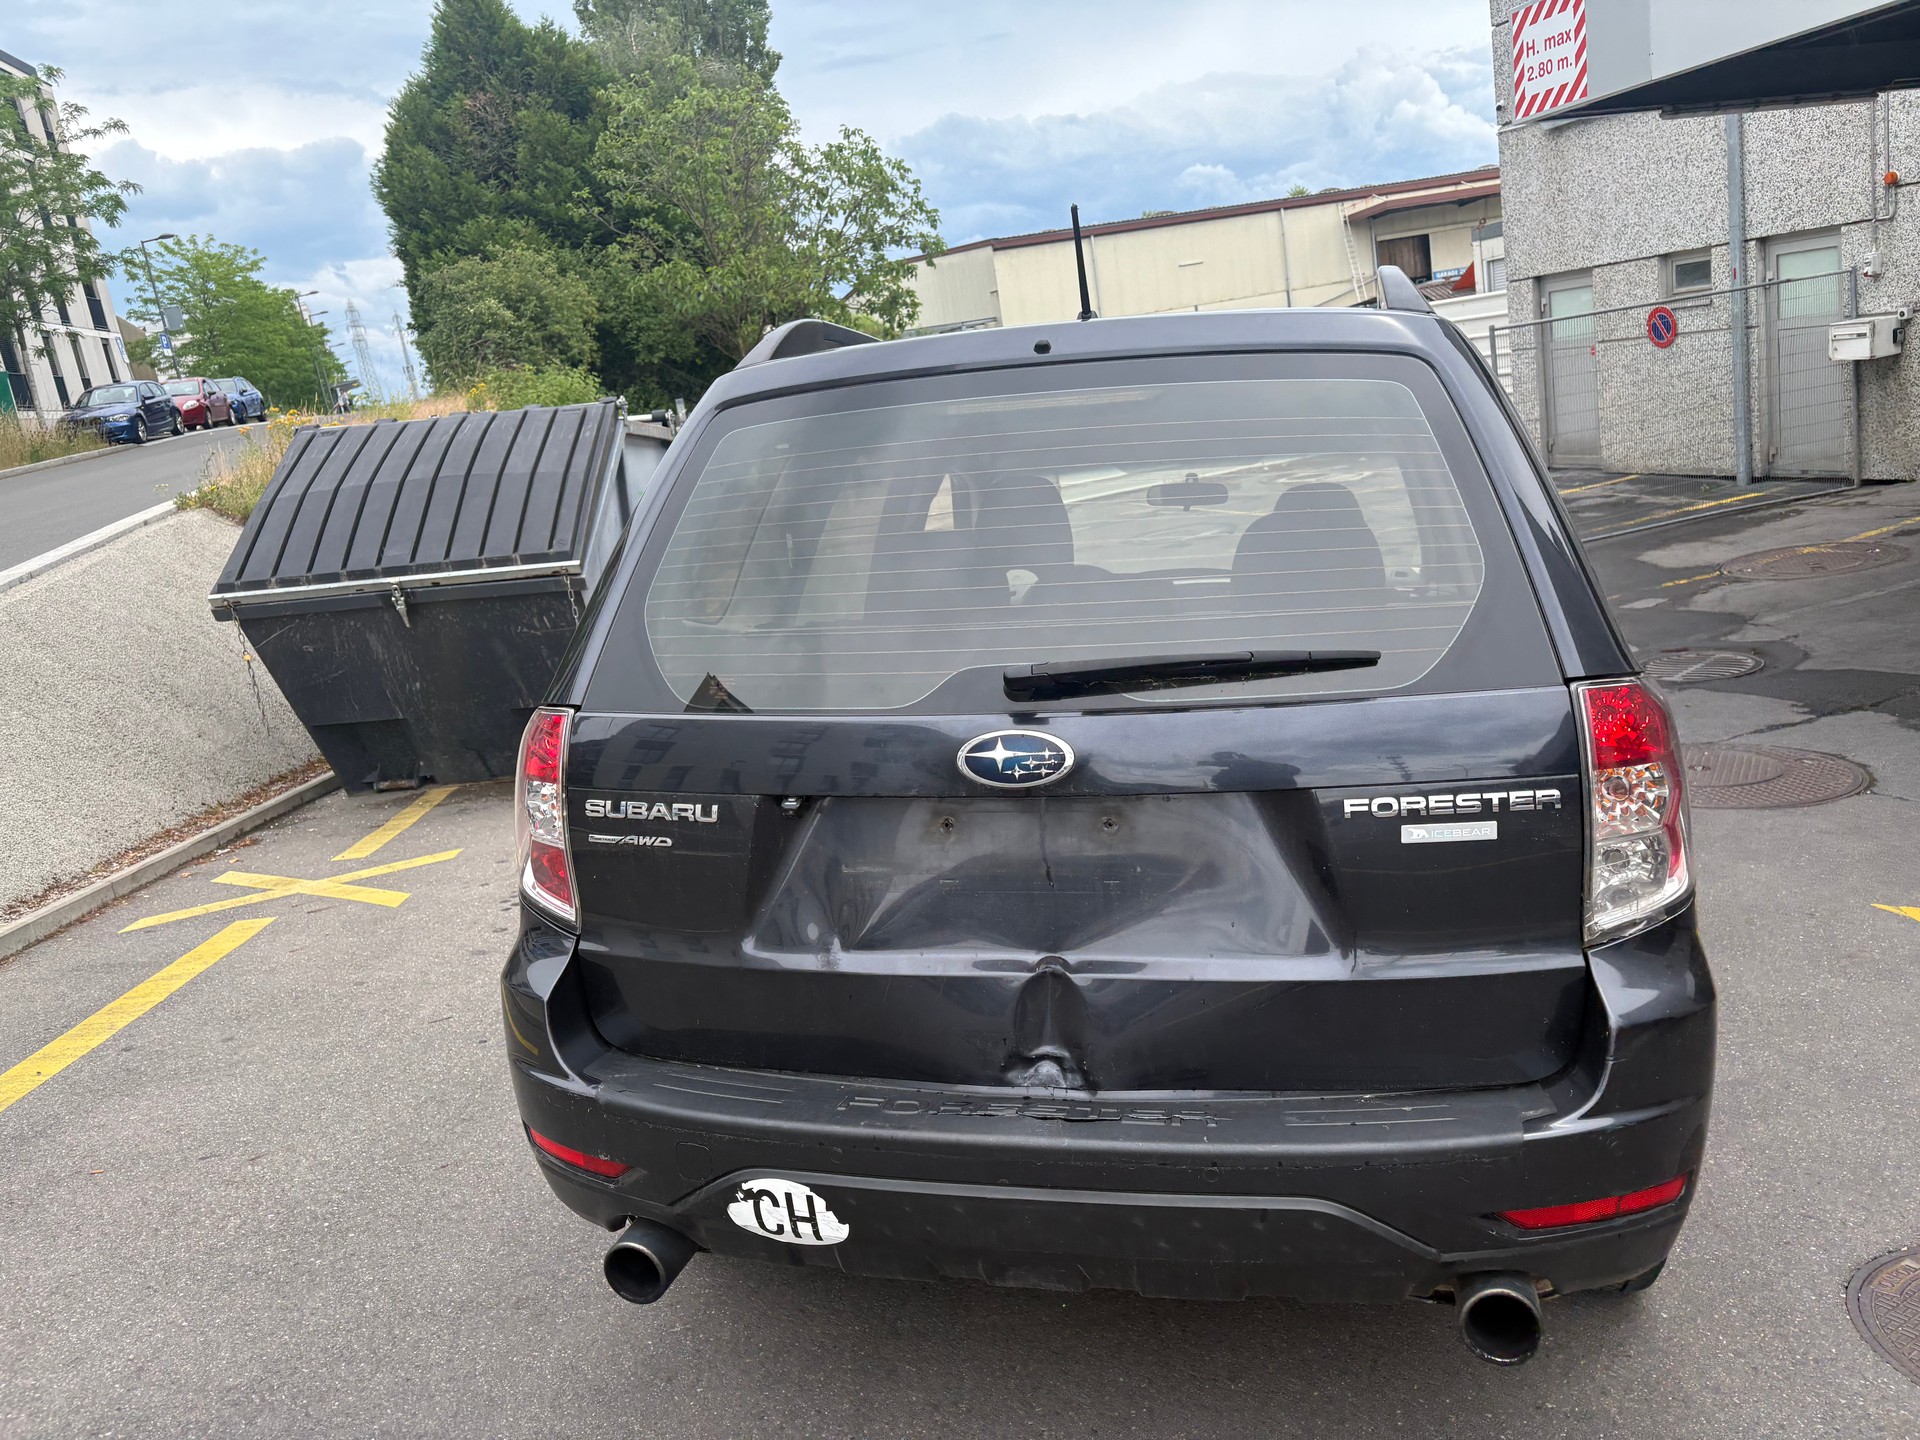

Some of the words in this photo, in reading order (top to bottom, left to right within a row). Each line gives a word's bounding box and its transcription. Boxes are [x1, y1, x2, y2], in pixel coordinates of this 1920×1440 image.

[1526, 39, 1539, 58] H.
[1544, 29, 1571, 51] max
[1527, 59, 1553, 82] 2.80
[1557, 56, 1572, 71] m.
[585, 799, 718, 822] SUBARU
[1343, 789, 1561, 818] FORESTER
[620, 835, 673, 847] AWD
[1431, 827, 1491, 838] ICEBEAR
[753, 1188, 823, 1241] CH
